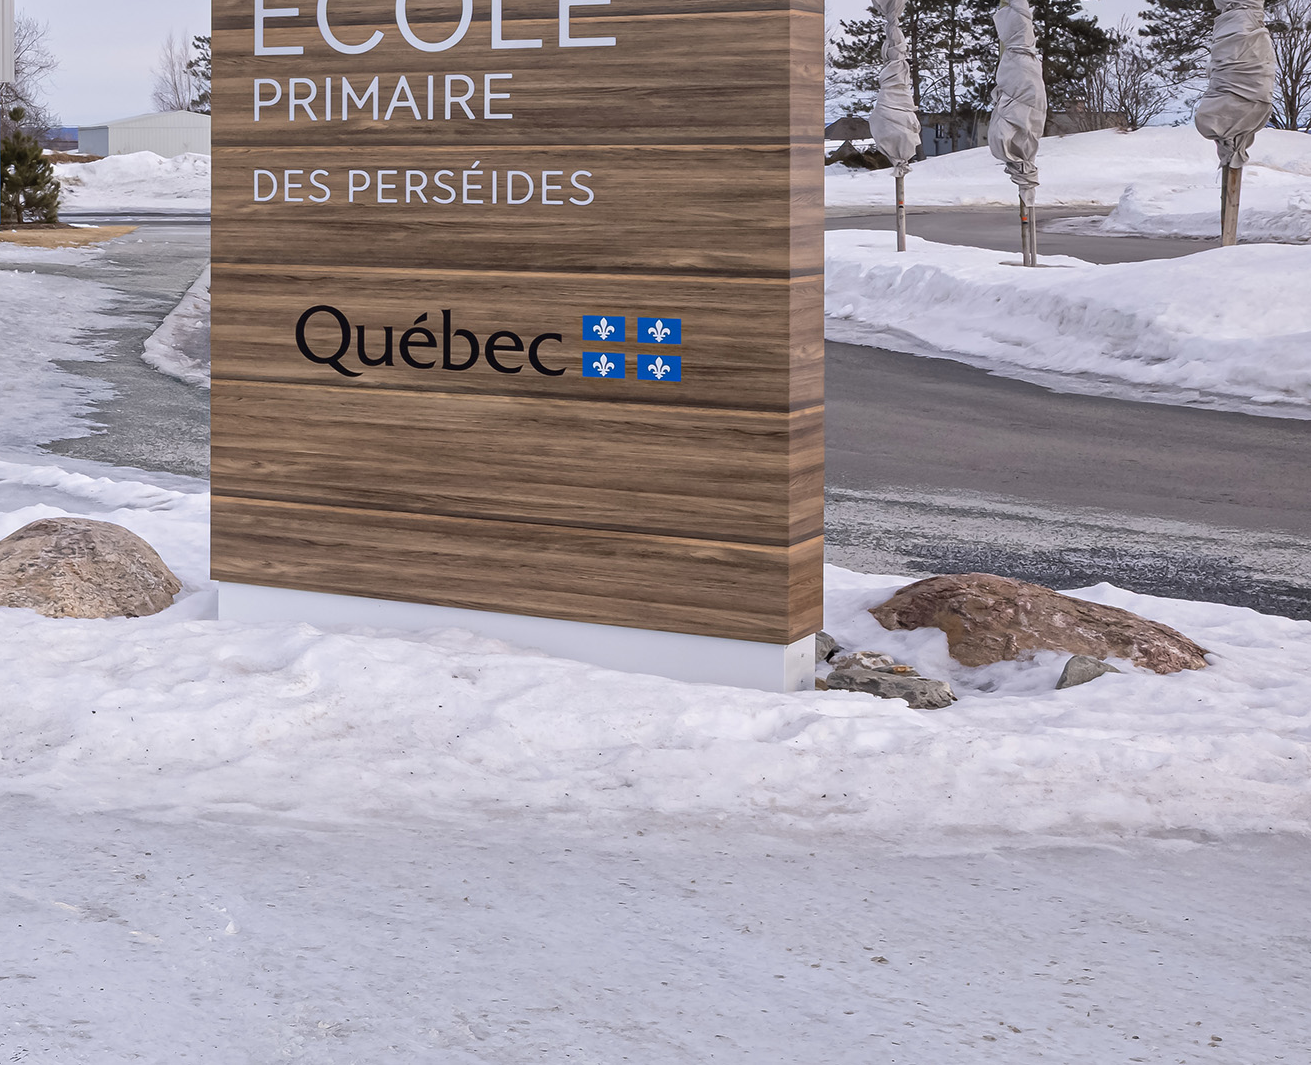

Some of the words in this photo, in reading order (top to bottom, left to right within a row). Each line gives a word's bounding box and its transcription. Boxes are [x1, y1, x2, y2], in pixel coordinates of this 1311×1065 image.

[252, 72, 513, 122] PRIMAIRE
[253, 169, 331, 203] DES
[348, 161, 595, 206] PERSÉIDES
[295, 304, 567, 378] Québec
